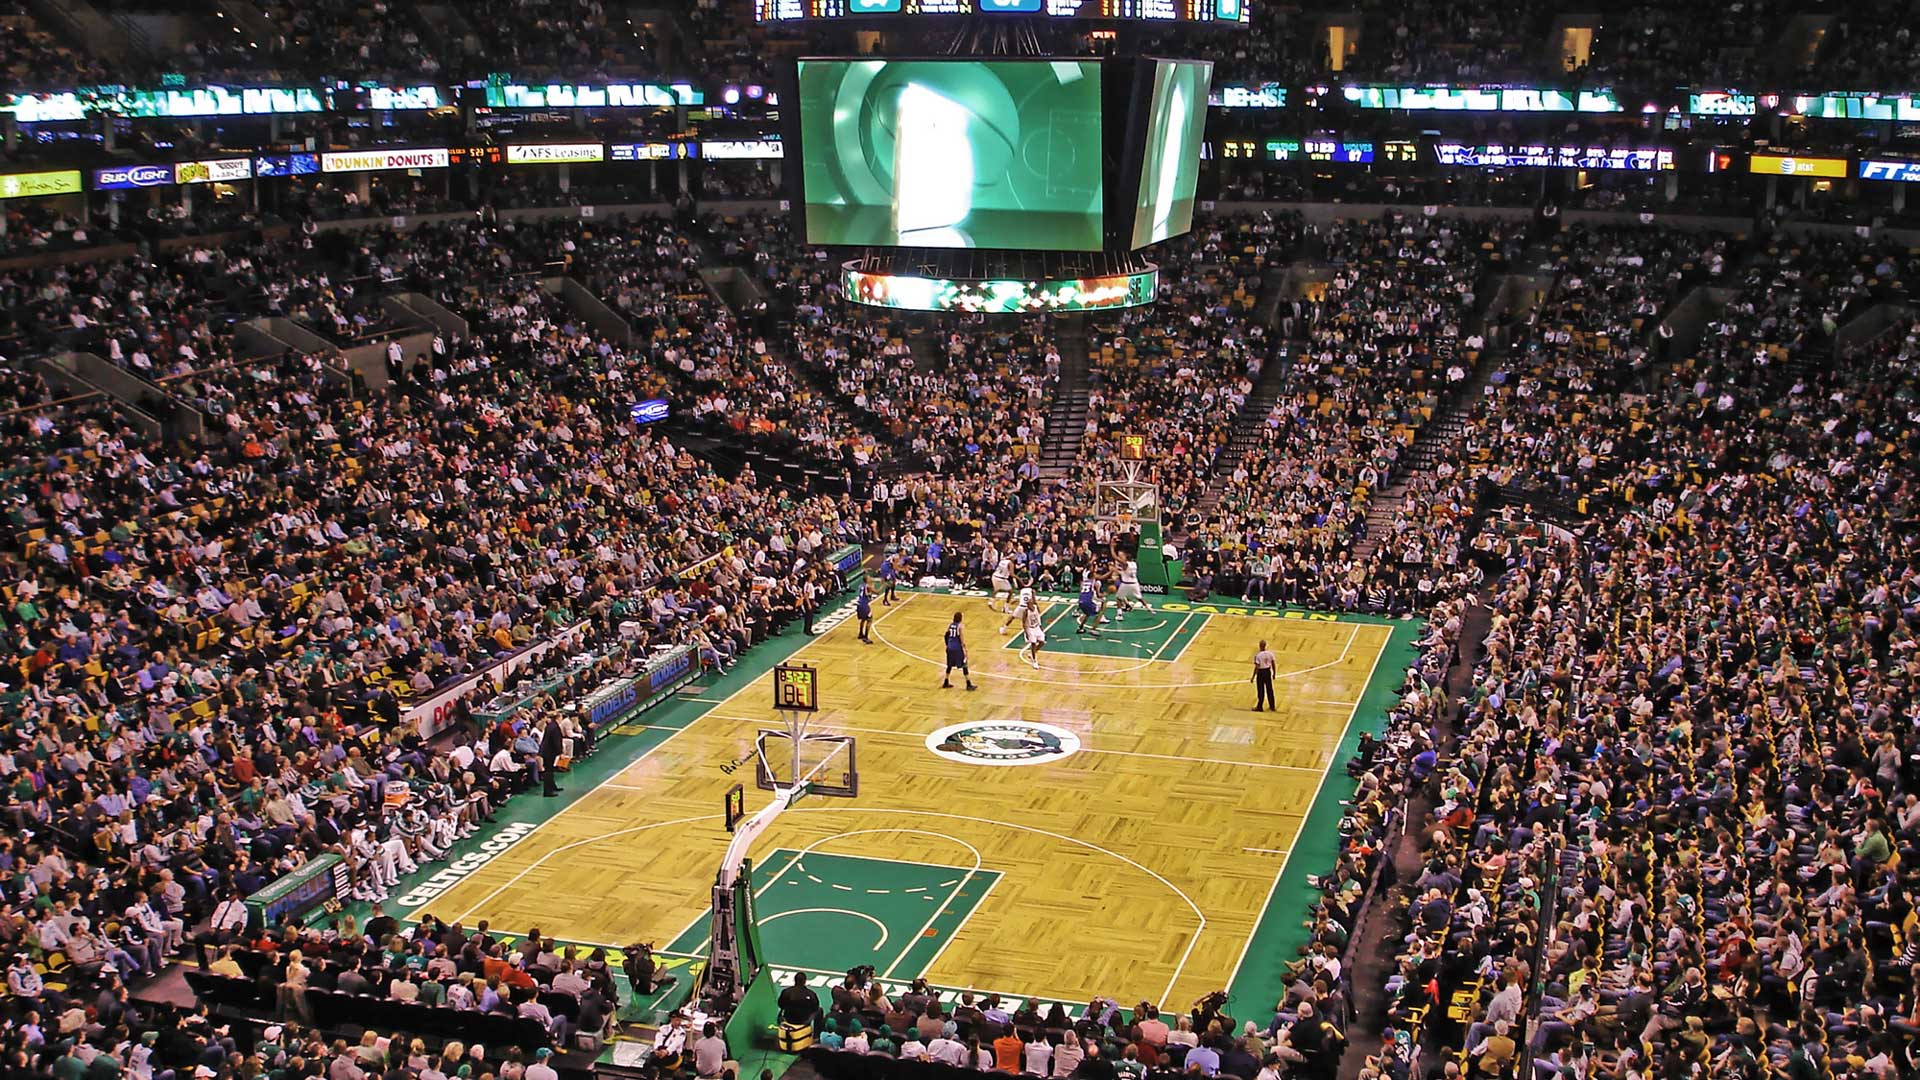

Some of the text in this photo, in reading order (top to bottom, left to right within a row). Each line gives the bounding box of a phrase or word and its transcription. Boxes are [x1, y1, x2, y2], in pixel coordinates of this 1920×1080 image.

[1223, 87, 1287, 108] DEFENSE
[1689, 93, 1756, 115] DEFENSE
[530, 148, 552, 159] NFS
[554, 147, 597, 160] Leasing
[1266, 142, 1299, 152] CELTICS
[1343, 143, 1373, 153] WOLVES
[335, 153, 434, 169] DUNKIN' DONUTS
[1719, 155, 1731, 169] 7
[101, 172, 128, 184] BUD
[133, 170, 169, 181] LIGHT
[1139, 584, 1163, 593] eebok
[1161, 602, 1338, 622] GARDEN
[786, 671, 811, 683] 5:23
[397, 821, 538, 907] CELTICS.COM
